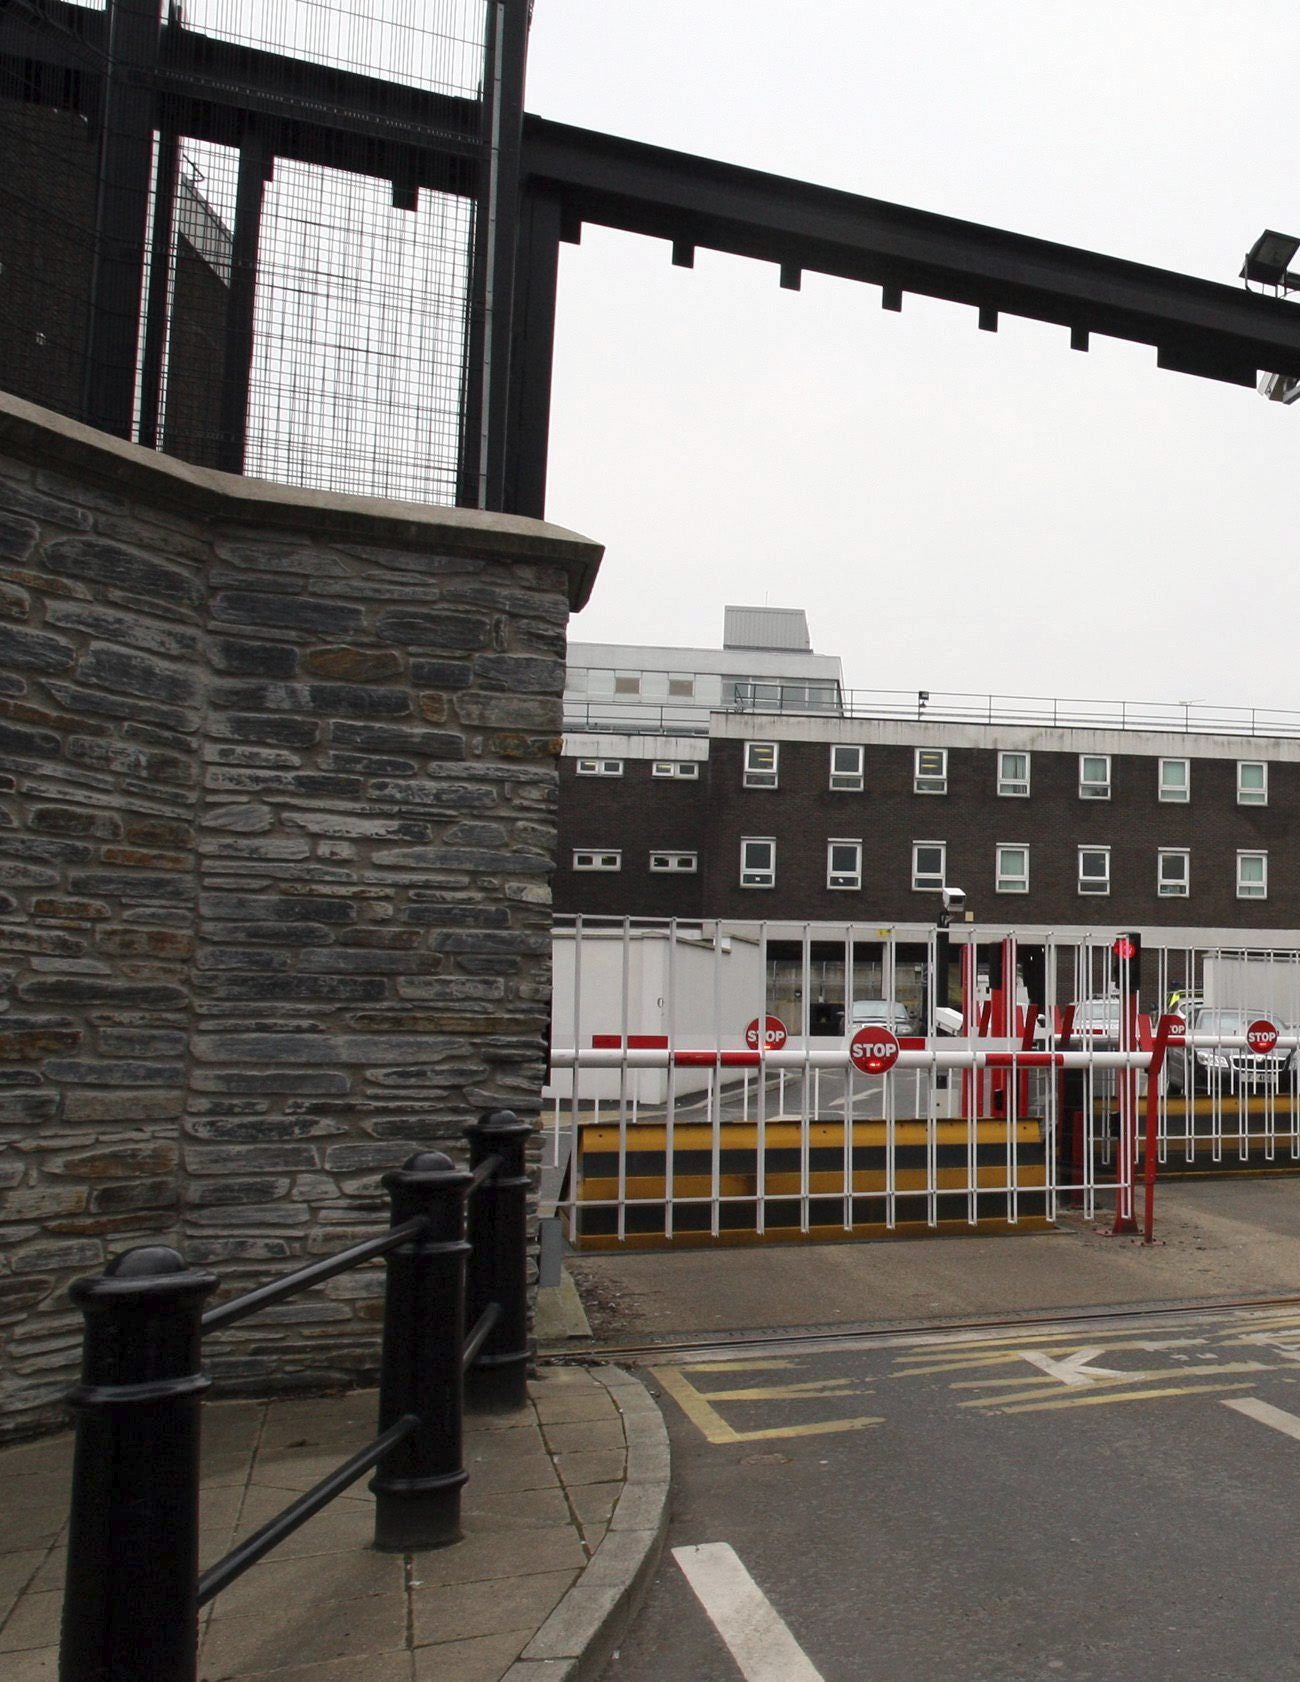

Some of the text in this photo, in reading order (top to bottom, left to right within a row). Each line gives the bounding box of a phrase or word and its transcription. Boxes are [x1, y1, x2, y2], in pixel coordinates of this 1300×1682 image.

[1169, 1024, 1185, 1034] OP
[747, 1030, 785, 1043] SOP
[1249, 1031, 1276, 1043] STOP
[852, 1043, 897, 1058] STOP
